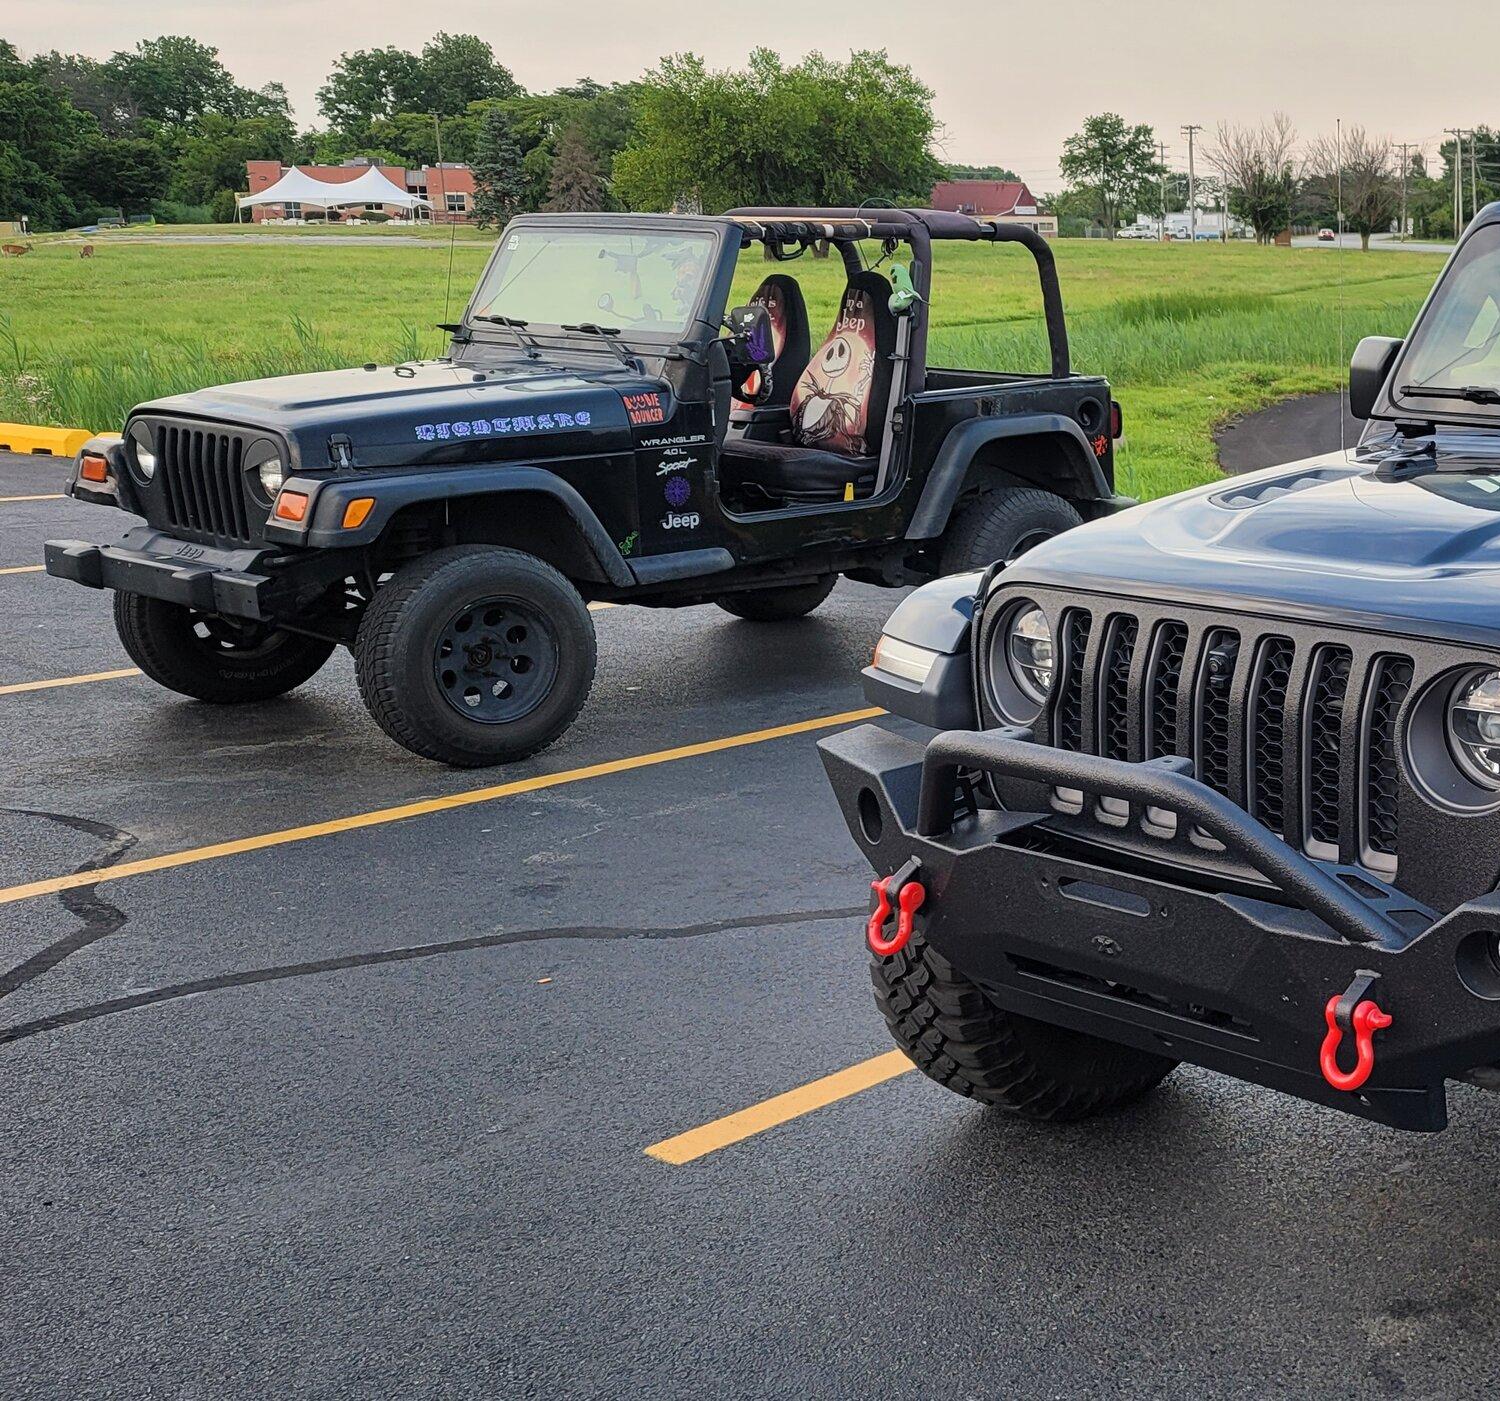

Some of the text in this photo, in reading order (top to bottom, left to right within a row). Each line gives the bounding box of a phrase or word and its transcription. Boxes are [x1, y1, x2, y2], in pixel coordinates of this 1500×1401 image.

[857, 301, 864, 309] a
[836, 309, 865, 333] Jeep
[630, 407, 664, 425] BOUNCER
[415, 411, 591, 441] NIGHTMARE
[640, 434, 706, 447] WRANGLER
[656, 456, 698, 477] Sport
[661, 511, 700, 530] Jeep
[175, 543, 205, 560] Jeep
